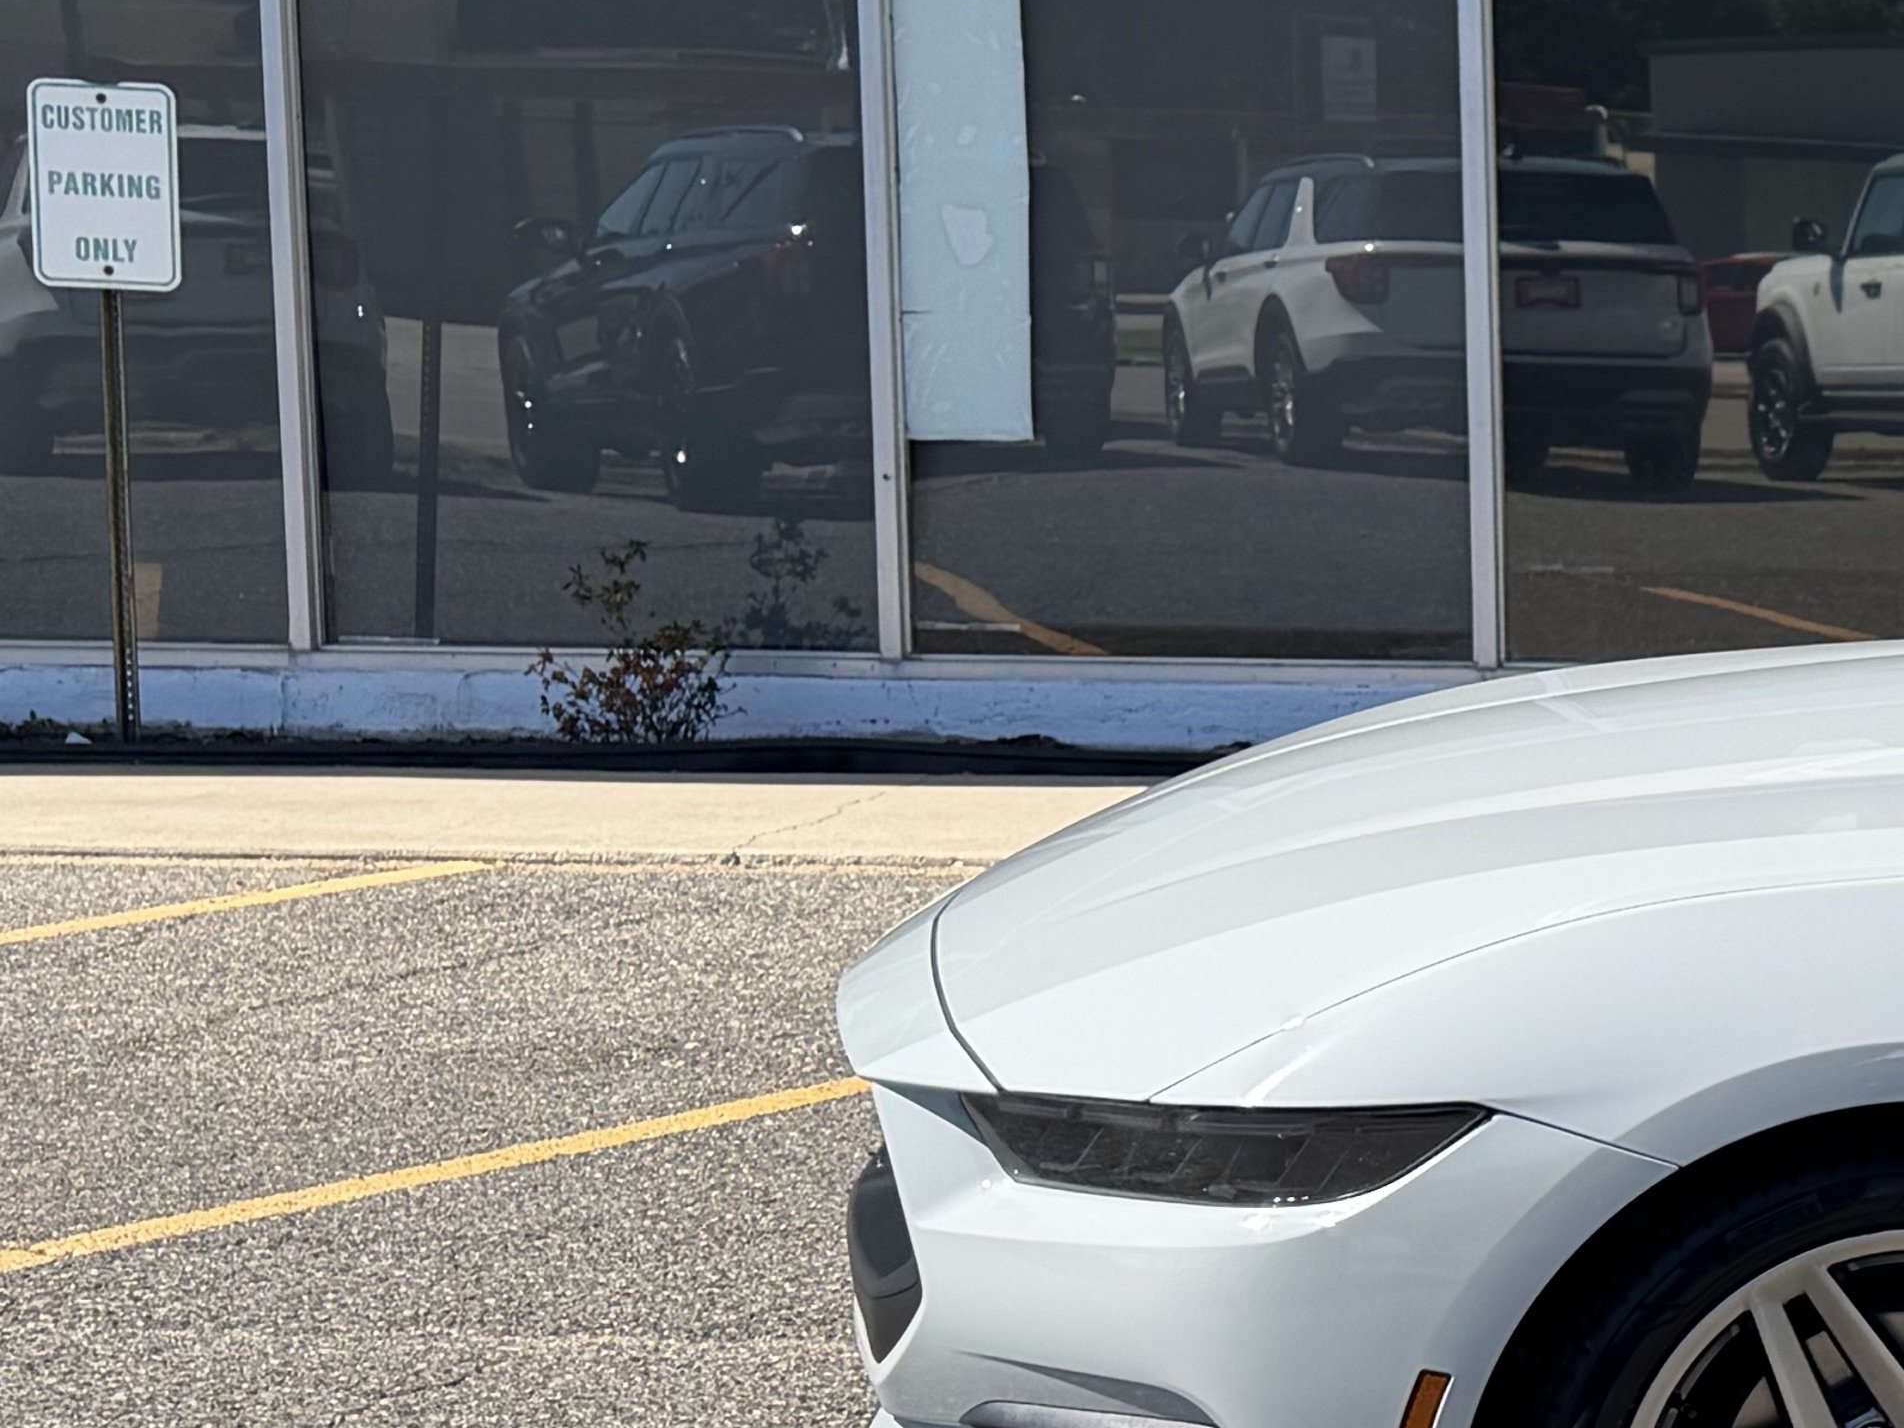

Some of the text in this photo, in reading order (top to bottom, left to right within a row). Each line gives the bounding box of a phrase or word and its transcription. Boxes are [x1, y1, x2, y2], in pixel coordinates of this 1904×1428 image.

[41, 103, 163, 135] CUSTOMER
[48, 170, 161, 200] PARKING
[75, 236, 138, 263] ONLY
